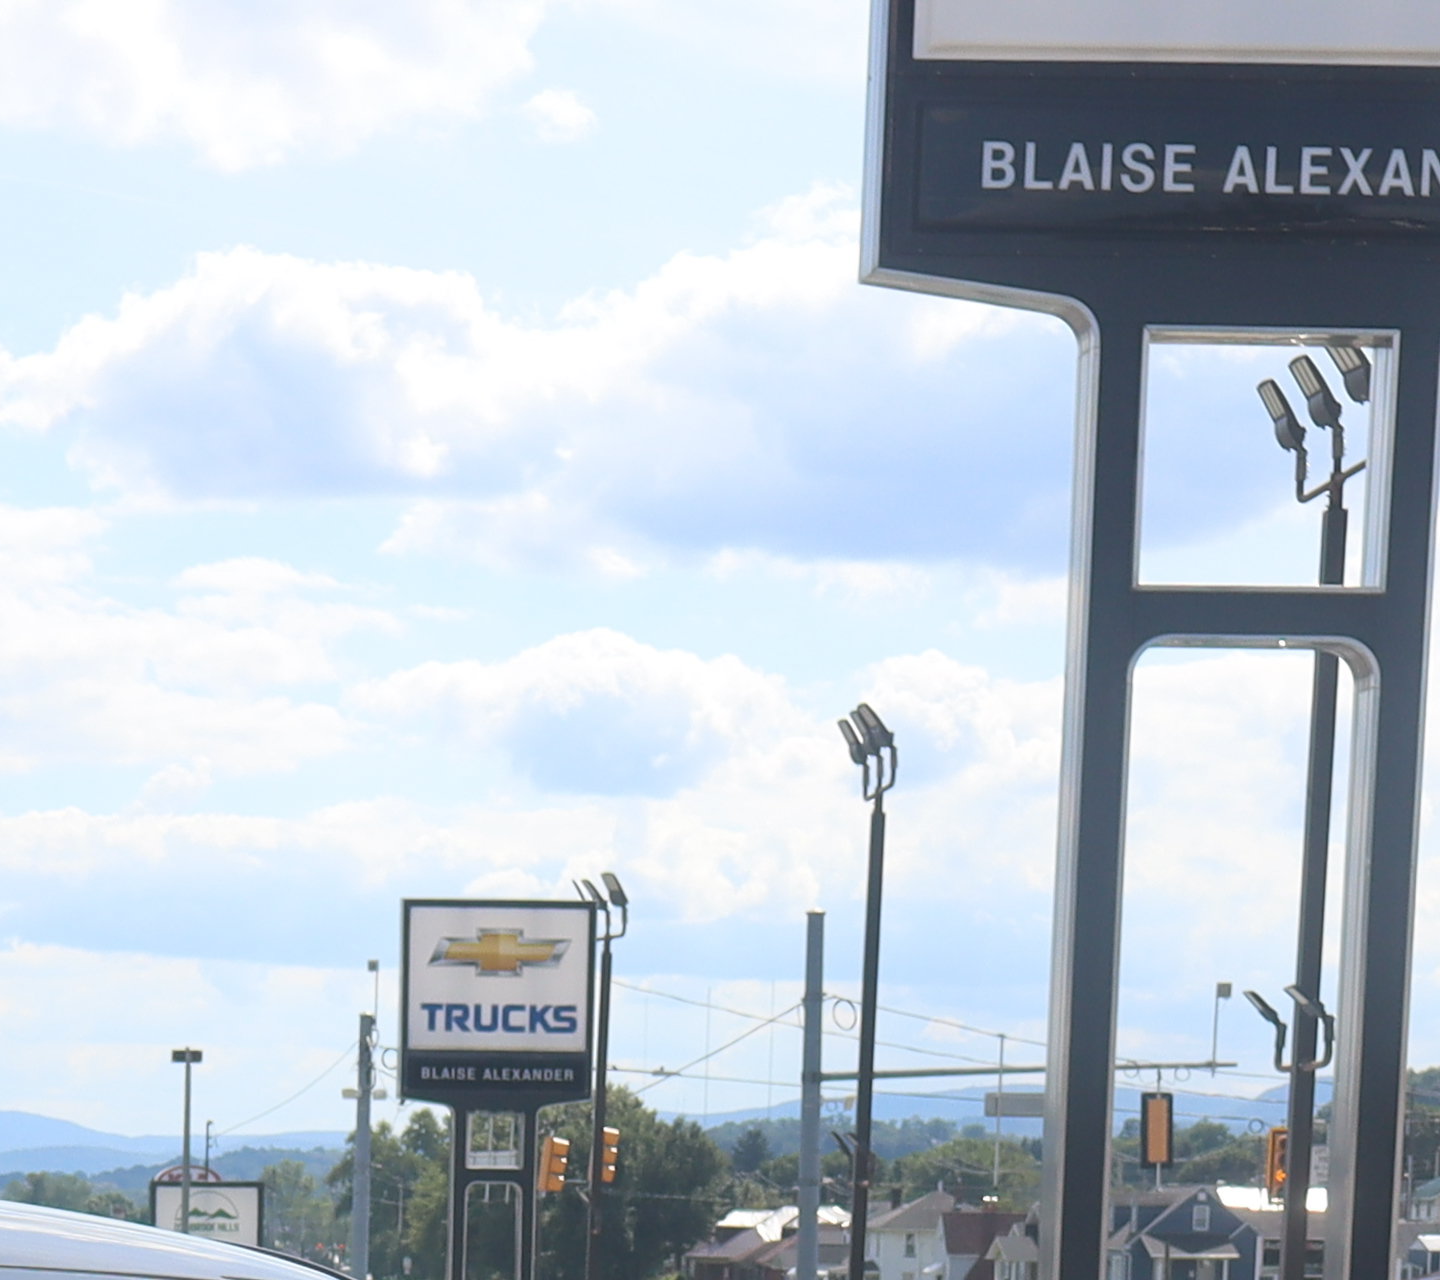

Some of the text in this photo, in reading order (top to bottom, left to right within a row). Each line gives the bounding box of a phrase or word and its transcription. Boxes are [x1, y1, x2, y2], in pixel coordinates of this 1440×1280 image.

[981, 140, 1196, 193] BLAISE
[421, 1003, 578, 1034] TRUCKS
[421, 1066, 575, 1082] BLAISE ALEXANDER
